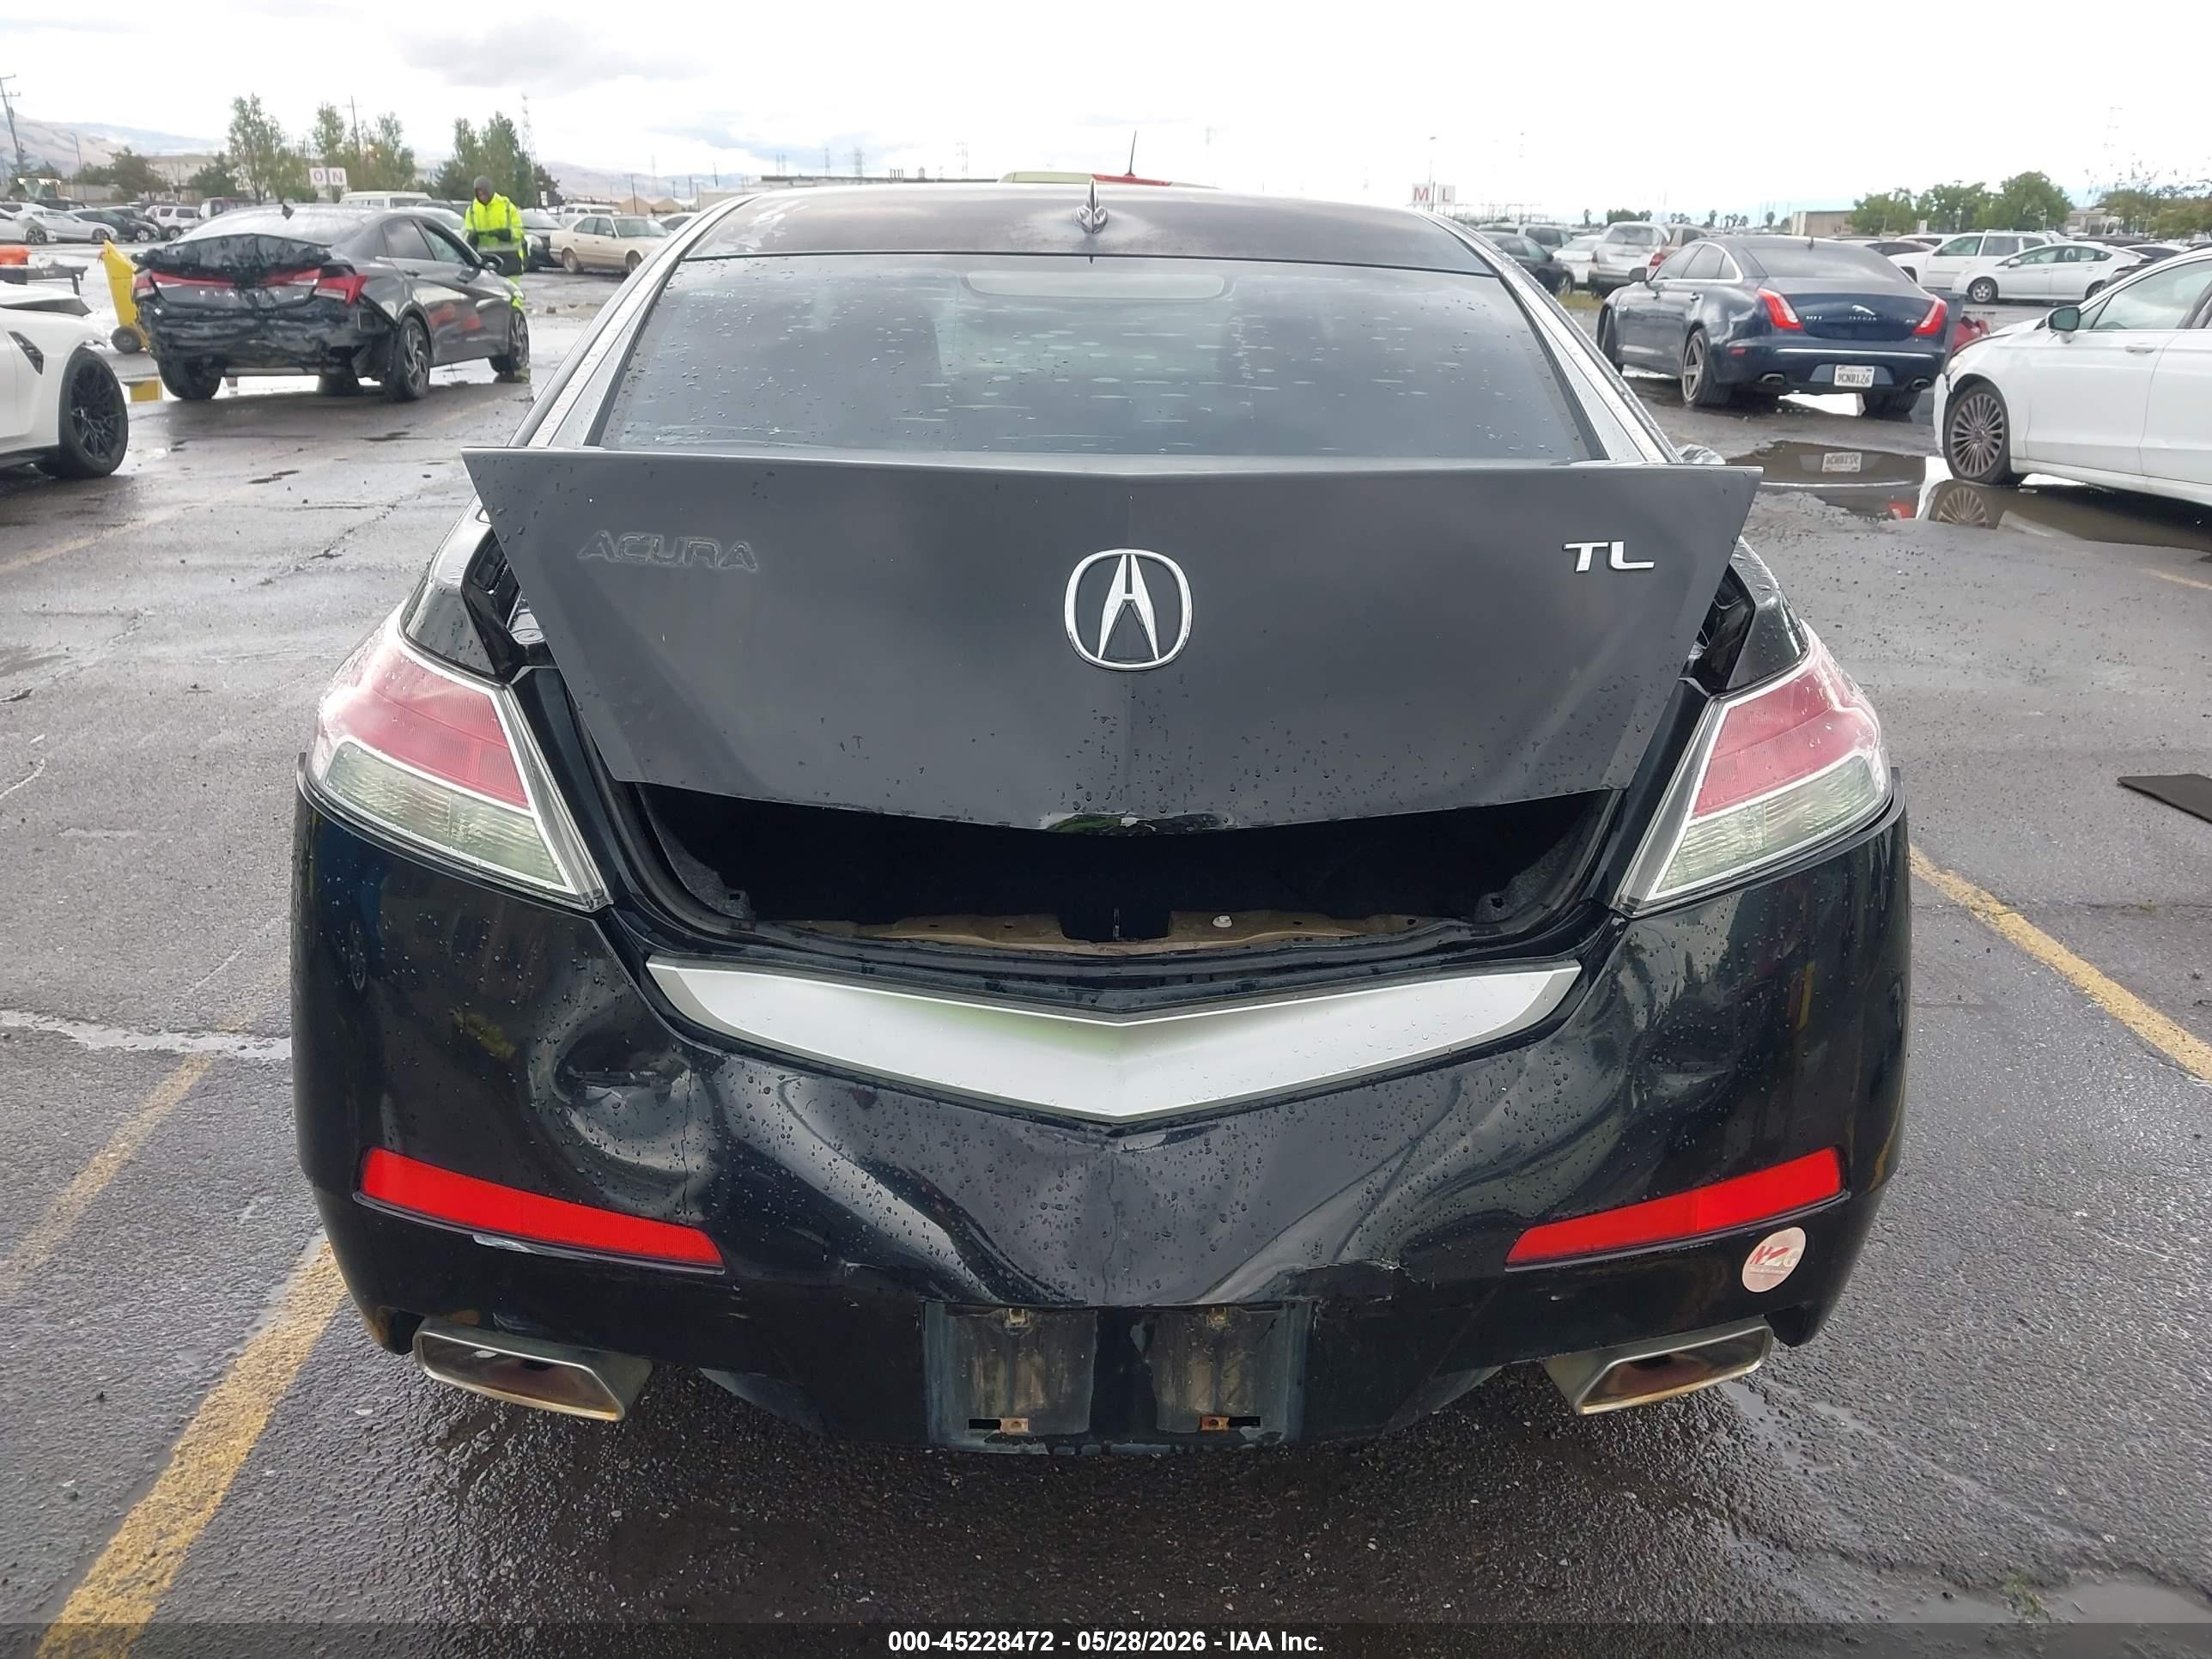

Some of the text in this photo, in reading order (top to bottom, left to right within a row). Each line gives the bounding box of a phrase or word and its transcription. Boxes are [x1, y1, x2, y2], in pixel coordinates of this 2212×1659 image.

[1413, 187, 1429, 201] M
[1442, 188, 1450, 202] L
[577, 529, 757, 572] ACURA
[1563, 540, 1655, 573] TL
